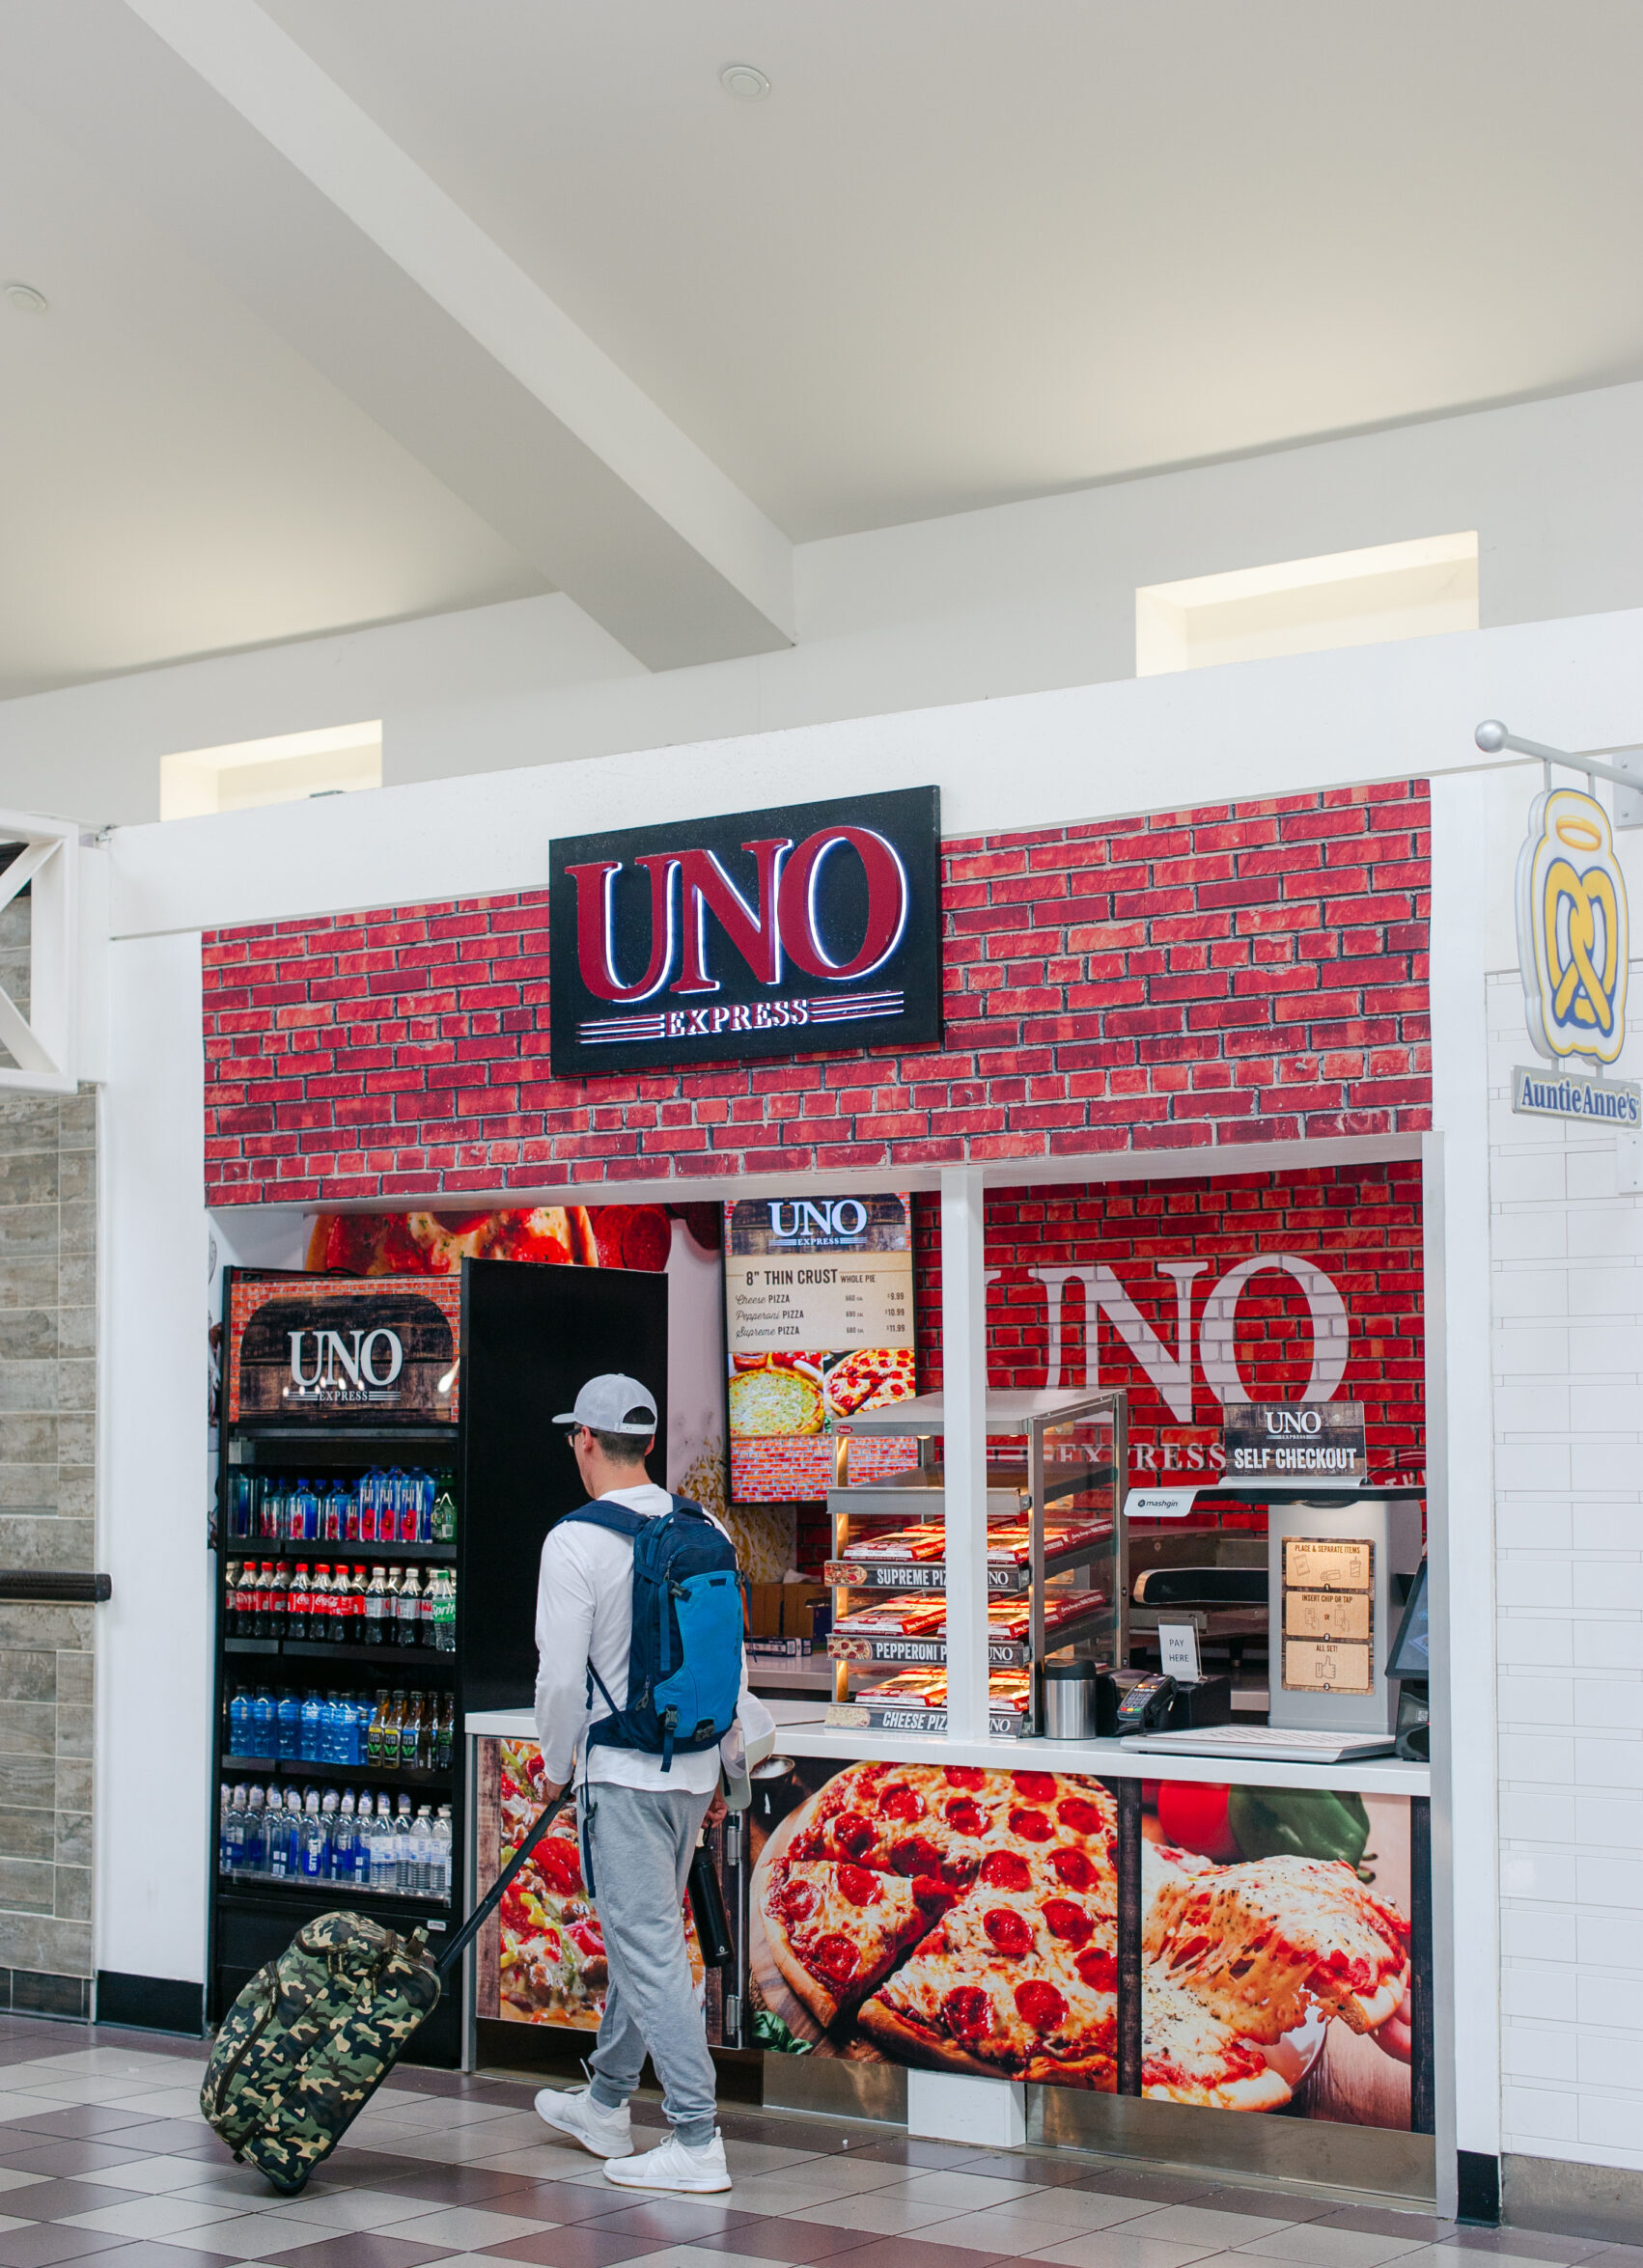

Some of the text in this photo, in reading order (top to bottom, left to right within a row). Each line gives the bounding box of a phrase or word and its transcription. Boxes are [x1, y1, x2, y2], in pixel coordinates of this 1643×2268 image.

[565, 825, 908, 1004] UNO
[664, 998, 810, 1037] EXPRESS
[1521, 1075, 1638, 1120] Auntie Anne's
[767, 1199, 868, 1237] UNO
[796, 1237, 840, 1246] EXPRESS
[746, 1268, 877, 1286] 8" THIN CRUST WHOLE PIE
[735, 1293, 766, 1306] Cheese
[768, 1294, 791, 1304] PIZZA
[735, 1310, 780, 1322] Pepperoni
[782, 1310, 804, 1319] PIZZA
[736, 1325, 776, 1339] Supreme
[778, 1325, 800, 1336] PIZZA
[287, 1328, 404, 1387] UNO
[319, 1390, 369, 1401] EXPRESS
[1265, 1410, 1322, 1434] UNO
[1057, 1442, 1226, 1471] EXRESS
[1234, 1448, 1357, 1469] SELF CHECKOUT
[1146, 1499, 1179, 1508] mashgin
[1295, 1544, 1311, 1553] PLACE
[1318, 1545, 1343, 1554] SEPARATE
[877, 1568, 929, 1586] SUPREME
[988, 1571, 1009, 1585] NO
[1302, 1593, 1320, 1602] INSERT
[1321, 1594, 1333, 1603] CHIP
[432, 1603, 456, 1618] Sprit
[876, 1642, 937, 1661] PEPPERONI
[1316, 1644, 1338, 1653] ALL SET!
[1169, 1653, 1189, 1663] HERE
[882, 1711, 926, 1729] CHEESE
[989, 1718, 1011, 1731] NO
[308, 1839, 319, 1872] smart
